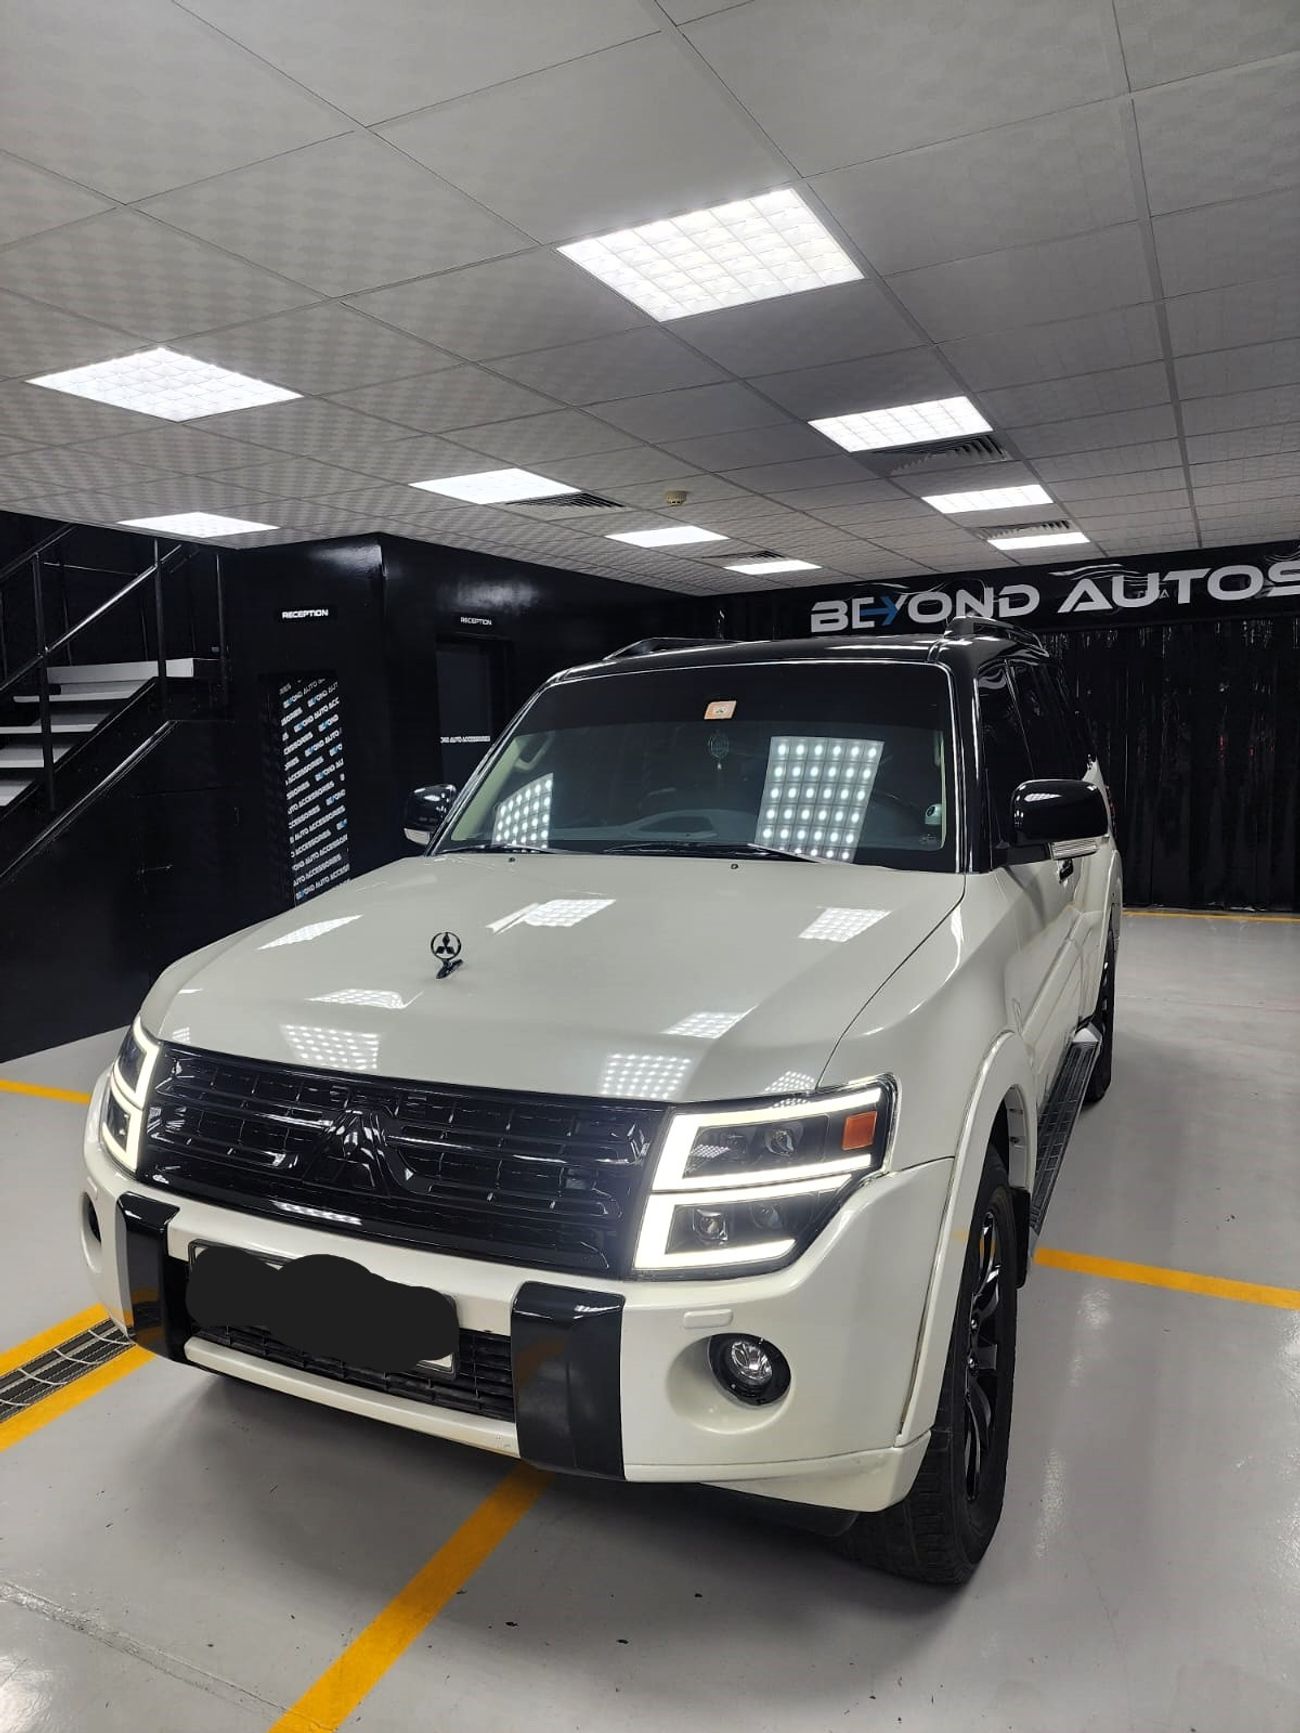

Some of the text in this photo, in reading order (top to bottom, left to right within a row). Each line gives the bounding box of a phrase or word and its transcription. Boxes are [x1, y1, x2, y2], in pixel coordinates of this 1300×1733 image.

[811, 560, 1300, 633] BEYOND AUTOS
[282, 609, 329, 619] RECEPTION
[461, 616, 492, 626] RECEPTION
